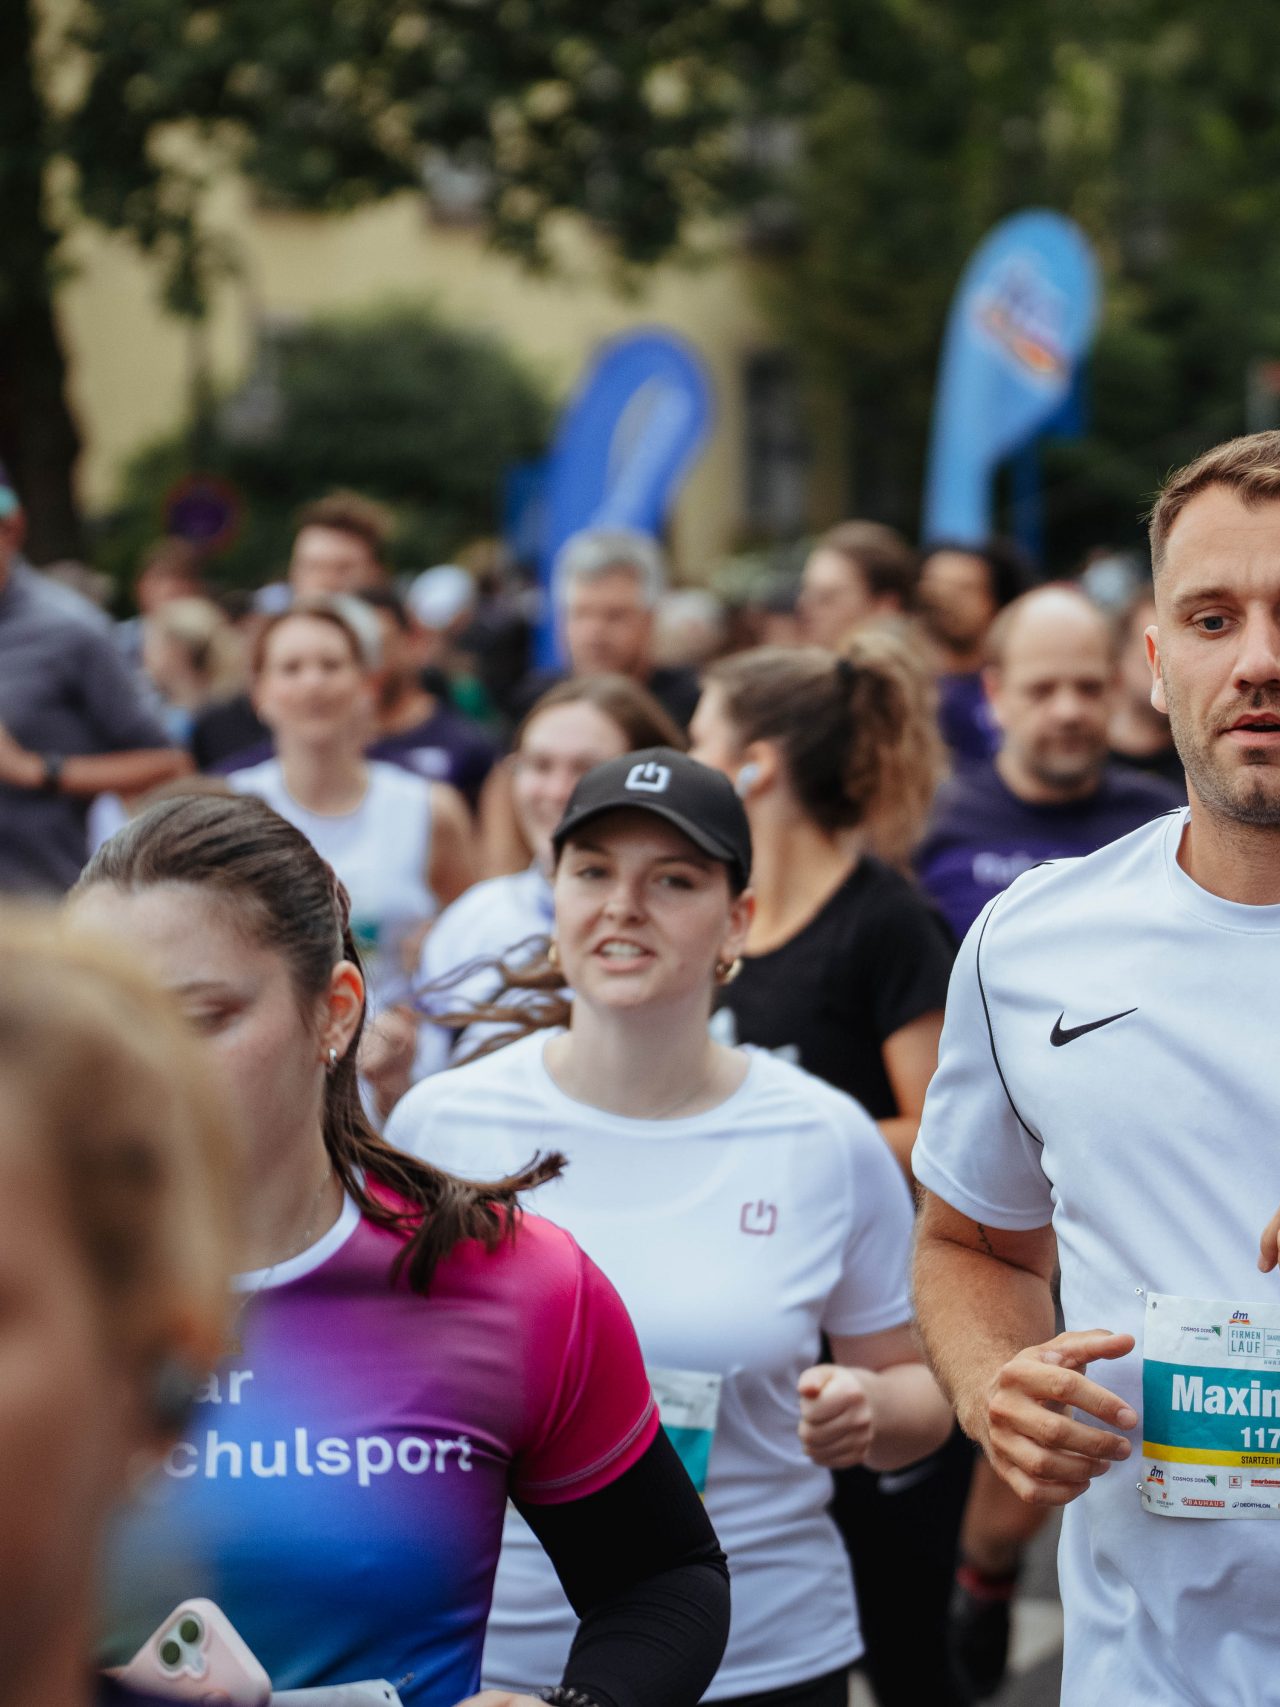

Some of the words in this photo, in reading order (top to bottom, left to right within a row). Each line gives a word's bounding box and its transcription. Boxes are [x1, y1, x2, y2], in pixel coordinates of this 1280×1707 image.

[1232, 1310, 1248, 1320] dm
[1231, 1329, 1261, 1340] FIRMEN
[1231, 1341, 1261, 1354] LAUF
[197, 1369, 254, 1404] ar
[163, 1427, 473, 1487] chulsport
[1241, 1455, 1275, 1465] STARTZEIT
[1150, 1465, 1164, 1479] dm
[1188, 1499, 1225, 1507] BAUHAUS
